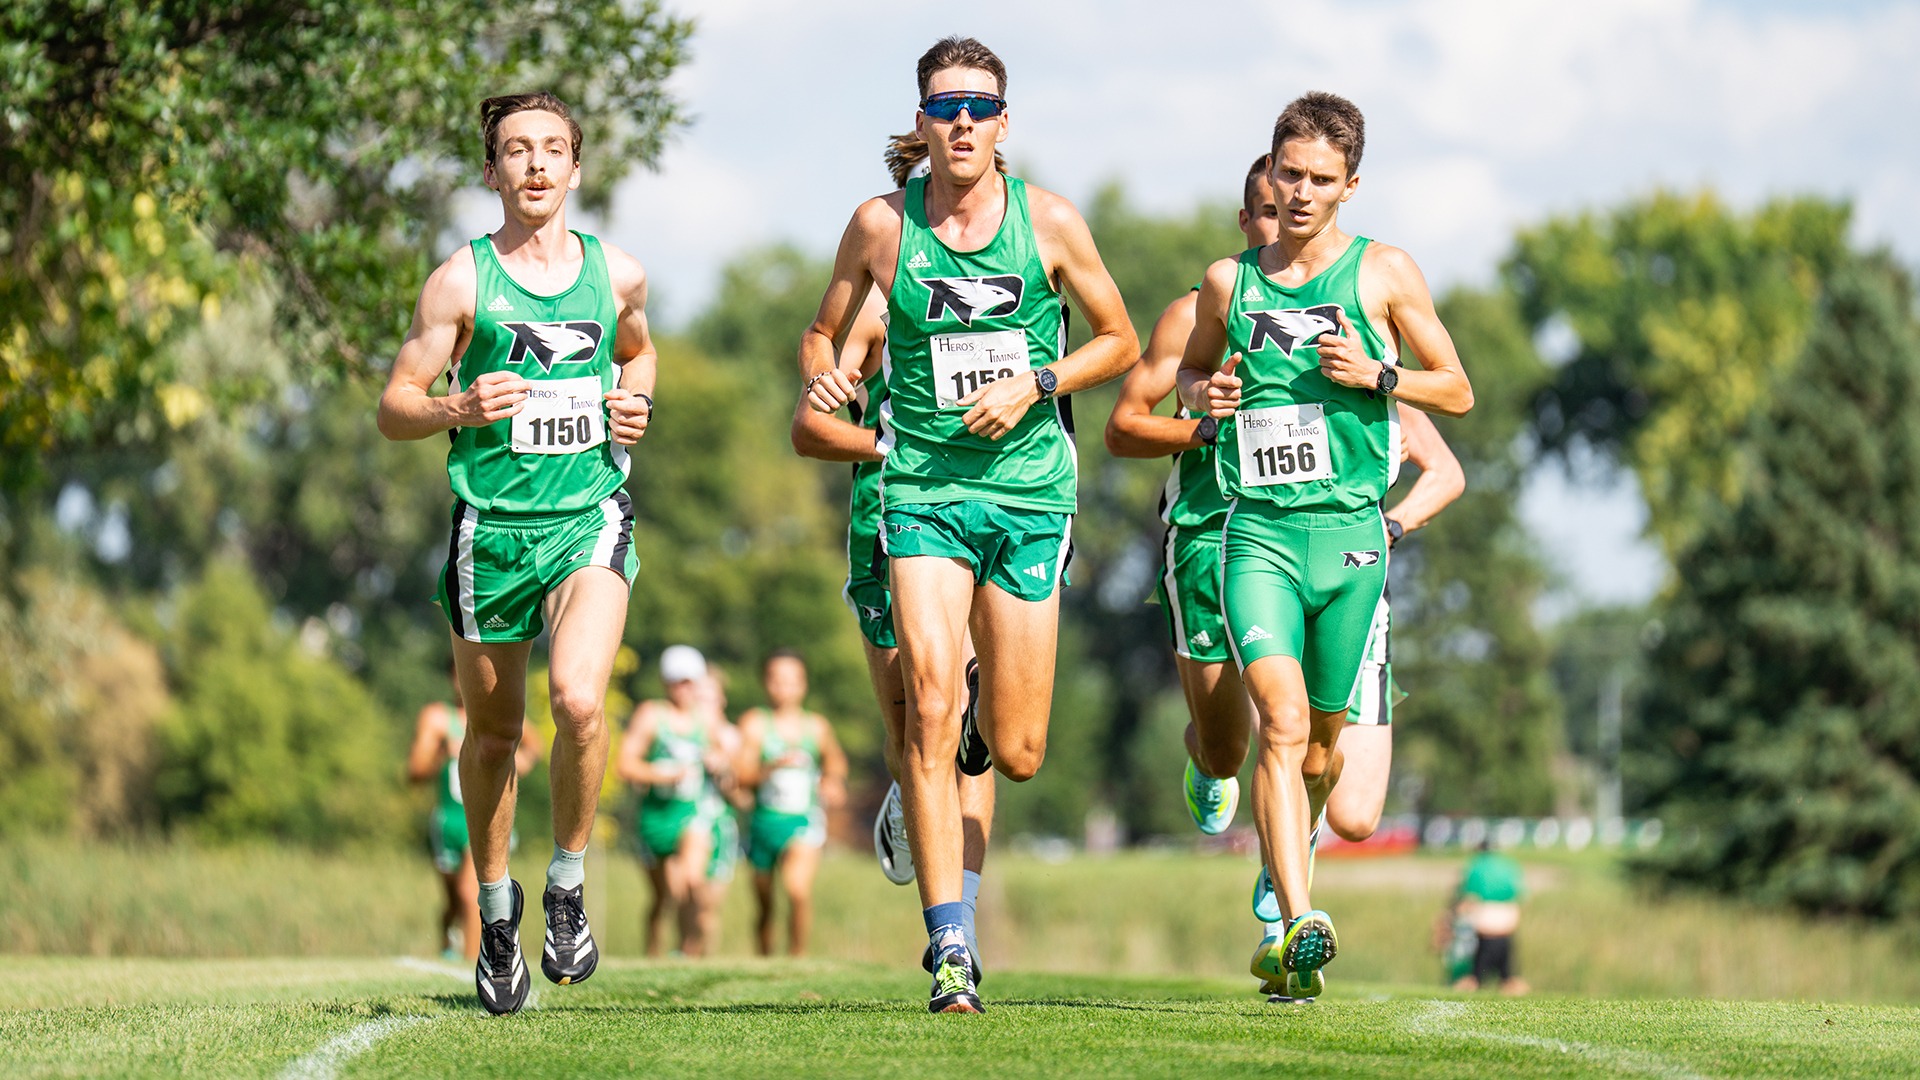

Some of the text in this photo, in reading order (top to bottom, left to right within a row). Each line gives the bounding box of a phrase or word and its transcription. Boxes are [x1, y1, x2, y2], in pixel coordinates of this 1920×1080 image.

[907, 261, 932, 269] adidas
[1241, 295, 1264, 303] adidas
[487, 304, 514, 312] adidas
[986, 349, 1020, 363] TIMING
[568, 395, 596, 410] TIMING
[529, 415, 591, 446] 1150
[1284, 423, 1319, 438] TIMING
[1253, 442, 1316, 478] 1156
[1241, 633, 1274, 647] adidas
